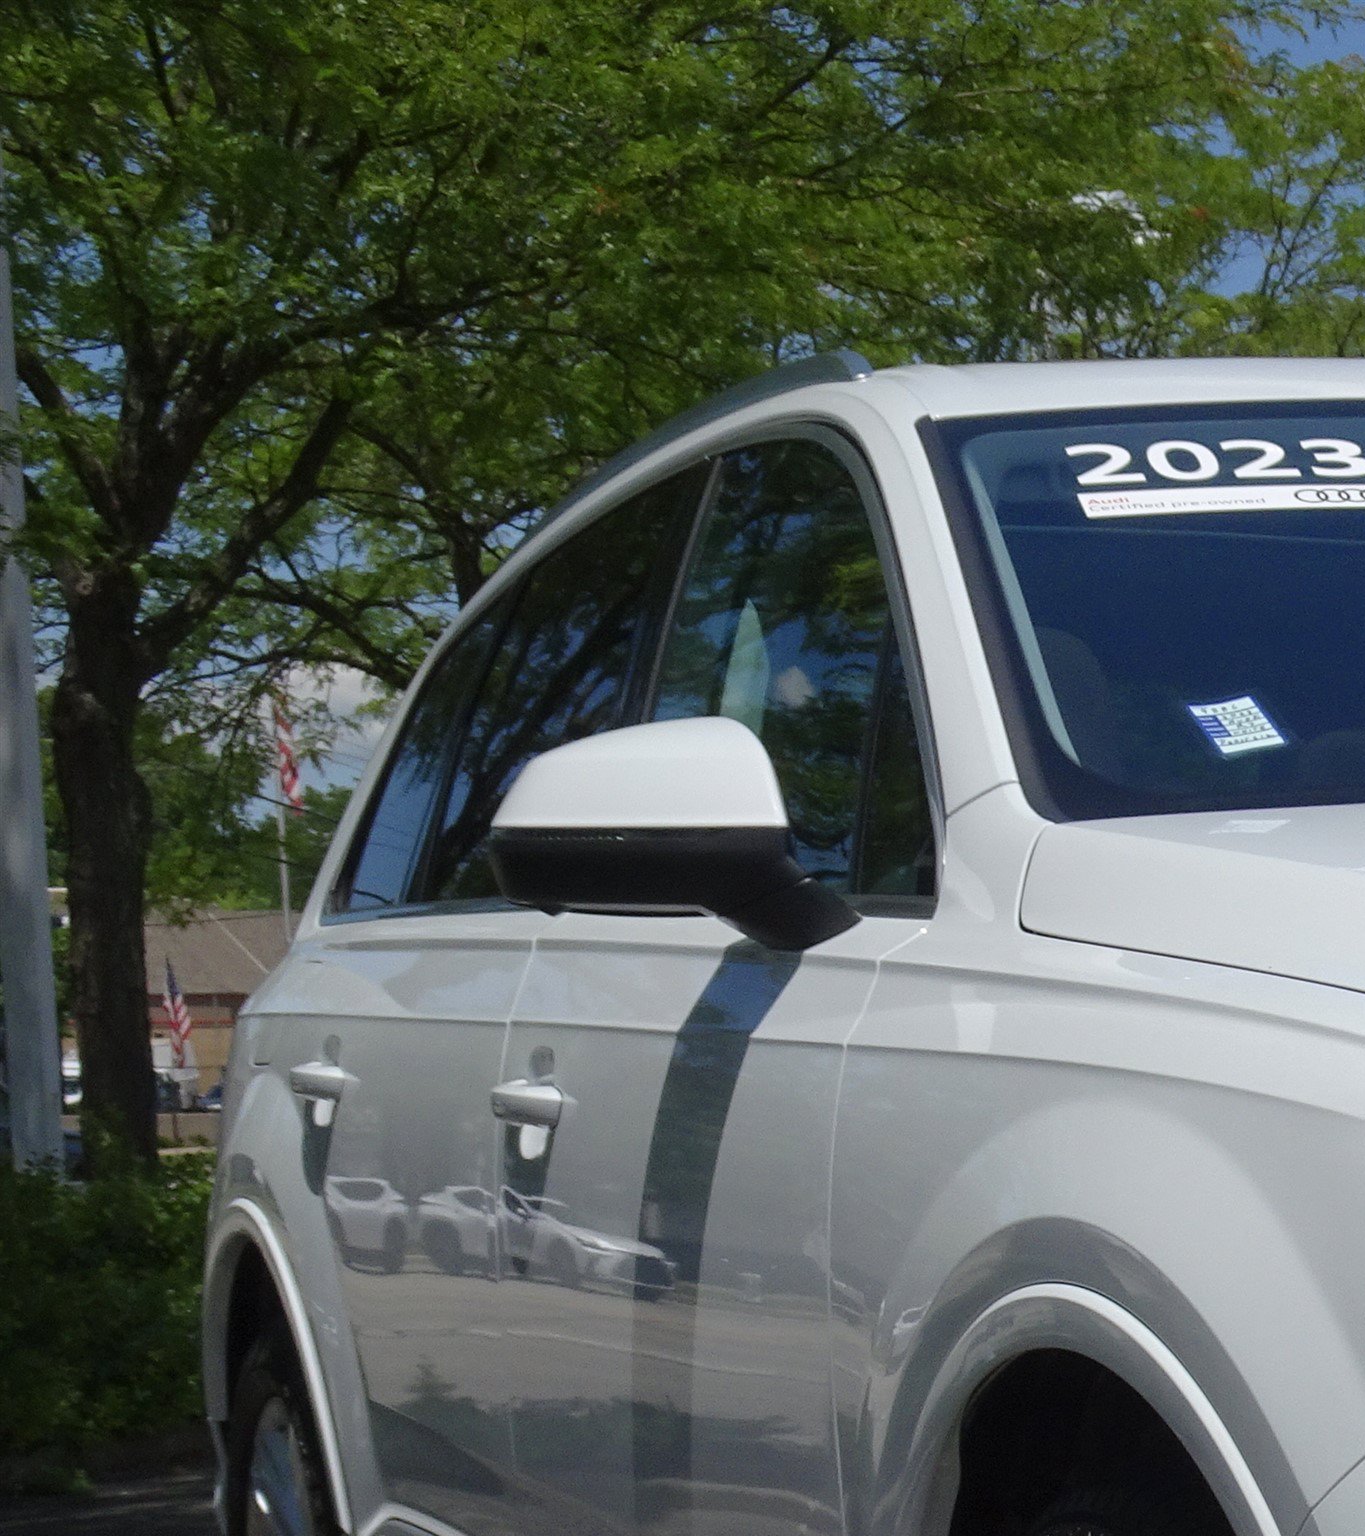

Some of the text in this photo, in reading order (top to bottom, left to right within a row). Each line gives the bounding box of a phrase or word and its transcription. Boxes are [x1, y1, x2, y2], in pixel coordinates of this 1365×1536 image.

[1088, 497, 1130, 505] Audi
[1089, 497, 1267, 512] Certified pre-owned
